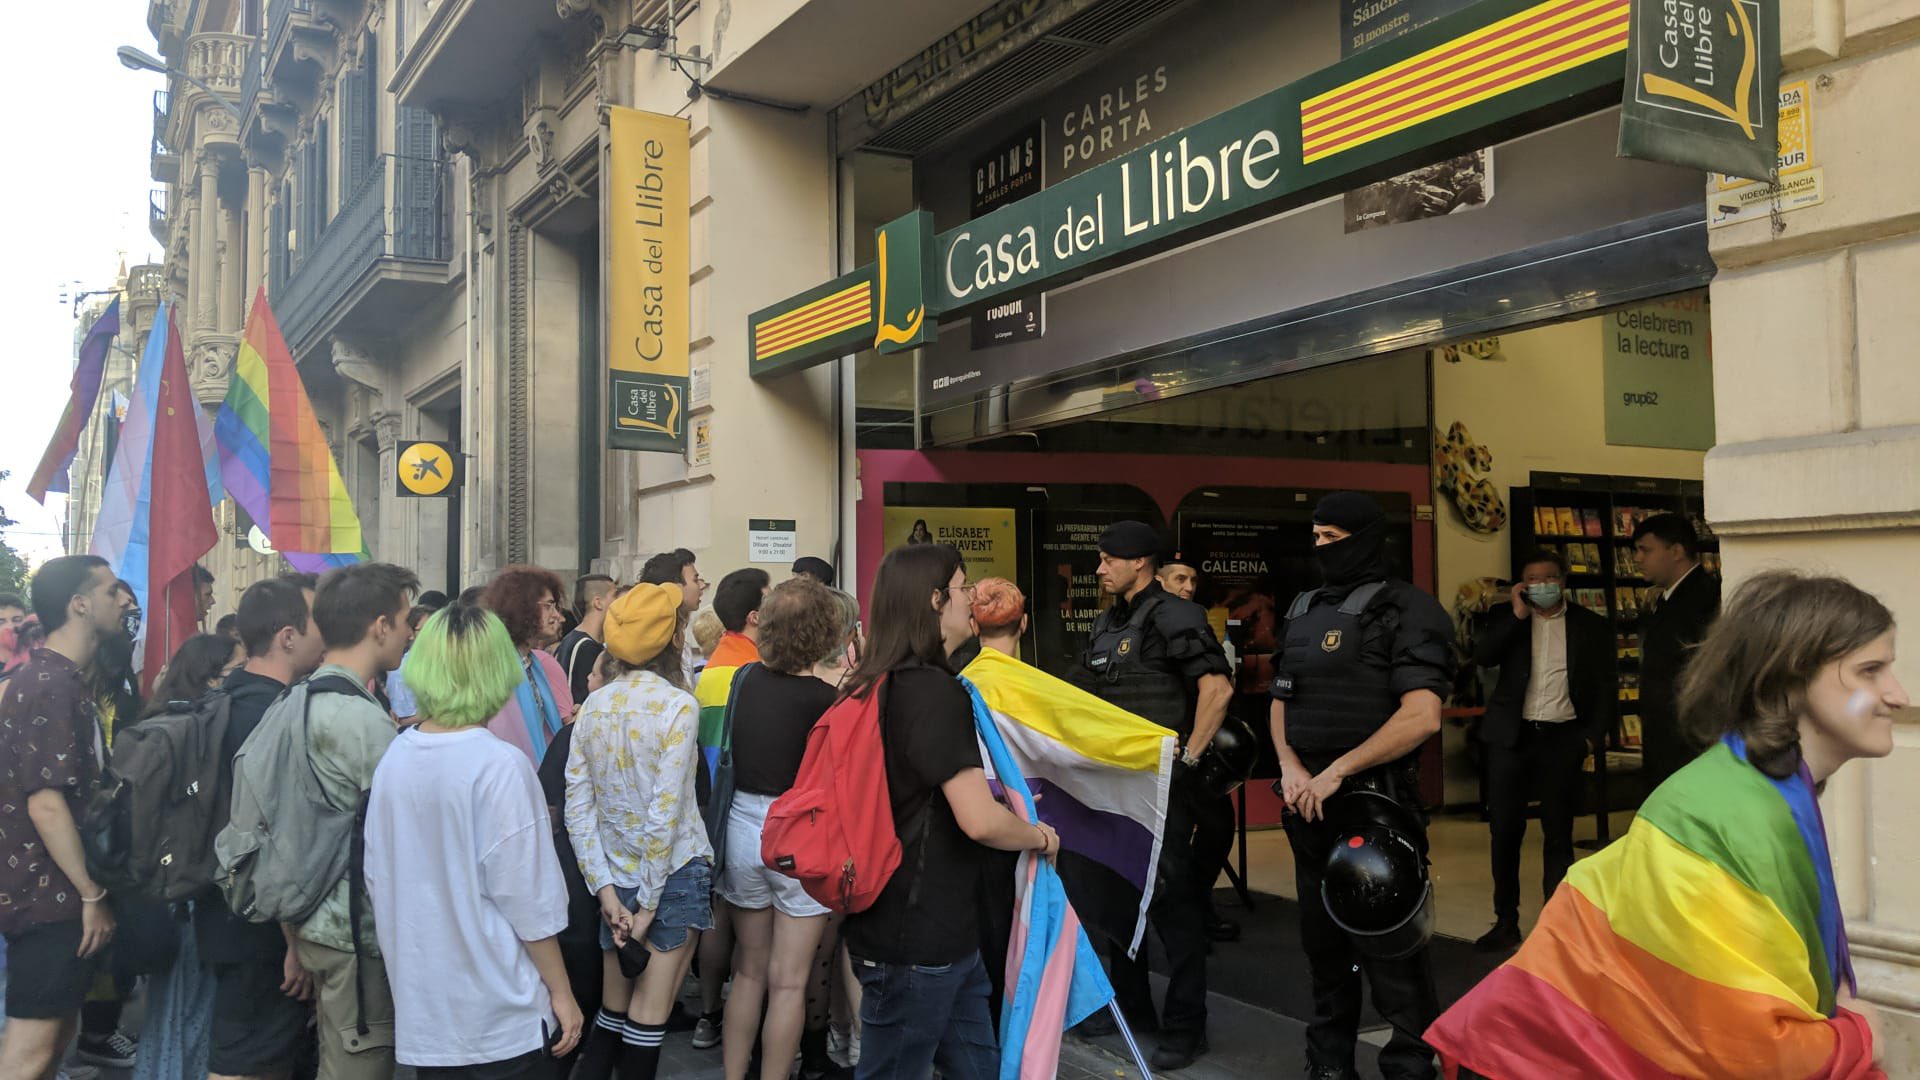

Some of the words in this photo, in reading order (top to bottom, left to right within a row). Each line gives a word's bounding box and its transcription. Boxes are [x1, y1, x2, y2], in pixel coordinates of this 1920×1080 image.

[1353, 33, 1364, 48] El
[1365, 12, 1410, 42] monstre
[1660, 0, 1679, 68] Casa
[1680, 1, 1695, 38] del
[1694, 7, 1714, 86] Llibre
[1063, 66, 1167, 137] CARLES
[1063, 108, 1151, 169] PORTA
[635, 139, 664, 227] Llibre
[976, 137, 1034, 195] CRIMS
[946, 225, 1040, 298] Casa
[1053, 193, 1104, 260] del
[1121, 129, 1280, 236] Llibre
[643, 238, 663, 274] del
[635, 285, 663, 361] Casa
[1616, 310, 1693, 336] Celebrem
[1617, 332, 1632, 353] la
[1635, 334, 1689, 360] lectura
[628, 388, 639, 415] Casa
[648, 389, 657, 421] Llibre
[1623, 391, 1659, 407] grup62
[938, 525, 991, 539] ELÍSABET
[1072, 575, 1097, 584] MANEL
[1201, 560, 1268, 574] GALERNA
[1060, 609, 1070, 618] LA
[1066, 622, 1076, 632] DE
